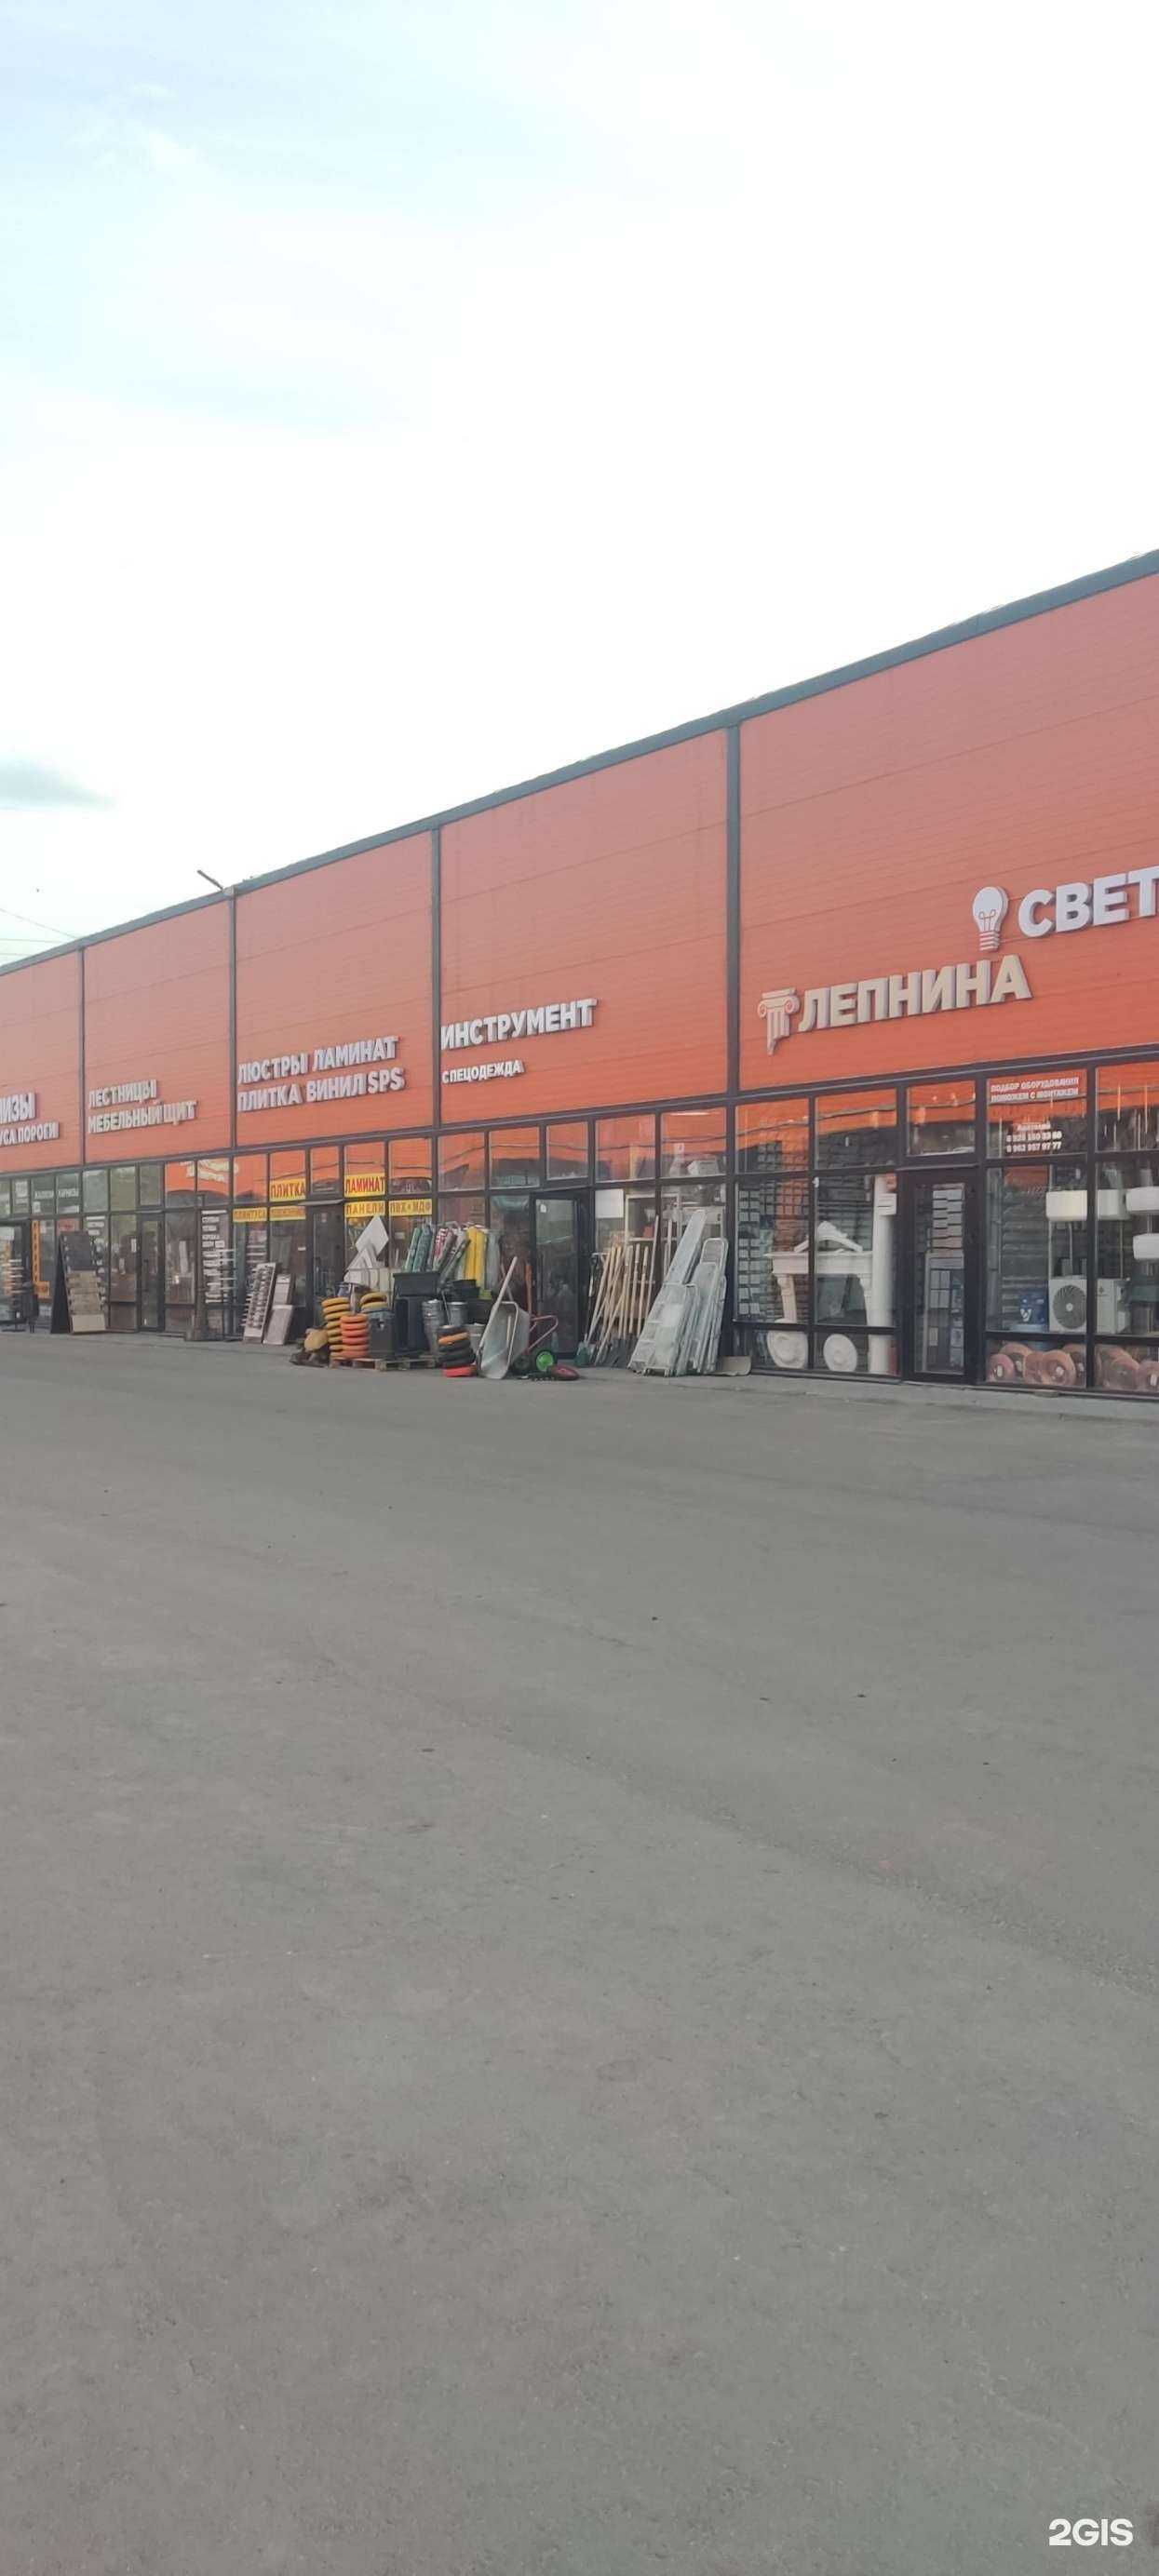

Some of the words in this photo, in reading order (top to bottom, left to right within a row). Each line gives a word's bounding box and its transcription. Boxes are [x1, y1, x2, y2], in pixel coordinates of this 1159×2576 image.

[1018, 865, 1159, 938] СВЕТ
[798, 954, 1032, 1033] ЛЕПНИНА
[440, 998, 598, 1051] ИНСТРУМЕНТ
[237, 1053, 308, 1084] ЛЮСТРЫ
[312, 1035, 399, 1072] ЛАМИНАТ
[442, 1059, 525, 1084] СПЕЦОДЕЖДА
[89, 1080, 157, 1107] ЛЕСТНИЦЫ
[237, 1084, 303, 1112] ПЛИТКА
[306, 1073, 367, 1102] ВИНИЛ
[368, 1067, 405, 1094] SPS
[88, 1099, 163, 1134] МЕБЕЛЬНЫЙ
[163, 1100, 196, 1126] ЩИТ
[271, 1182, 305, 1199] ПЛИТКА
[345, 1177, 385, 1194] ЛАМИНАТ
[346, 1202, 384, 1214] ПАНЕЛИ
